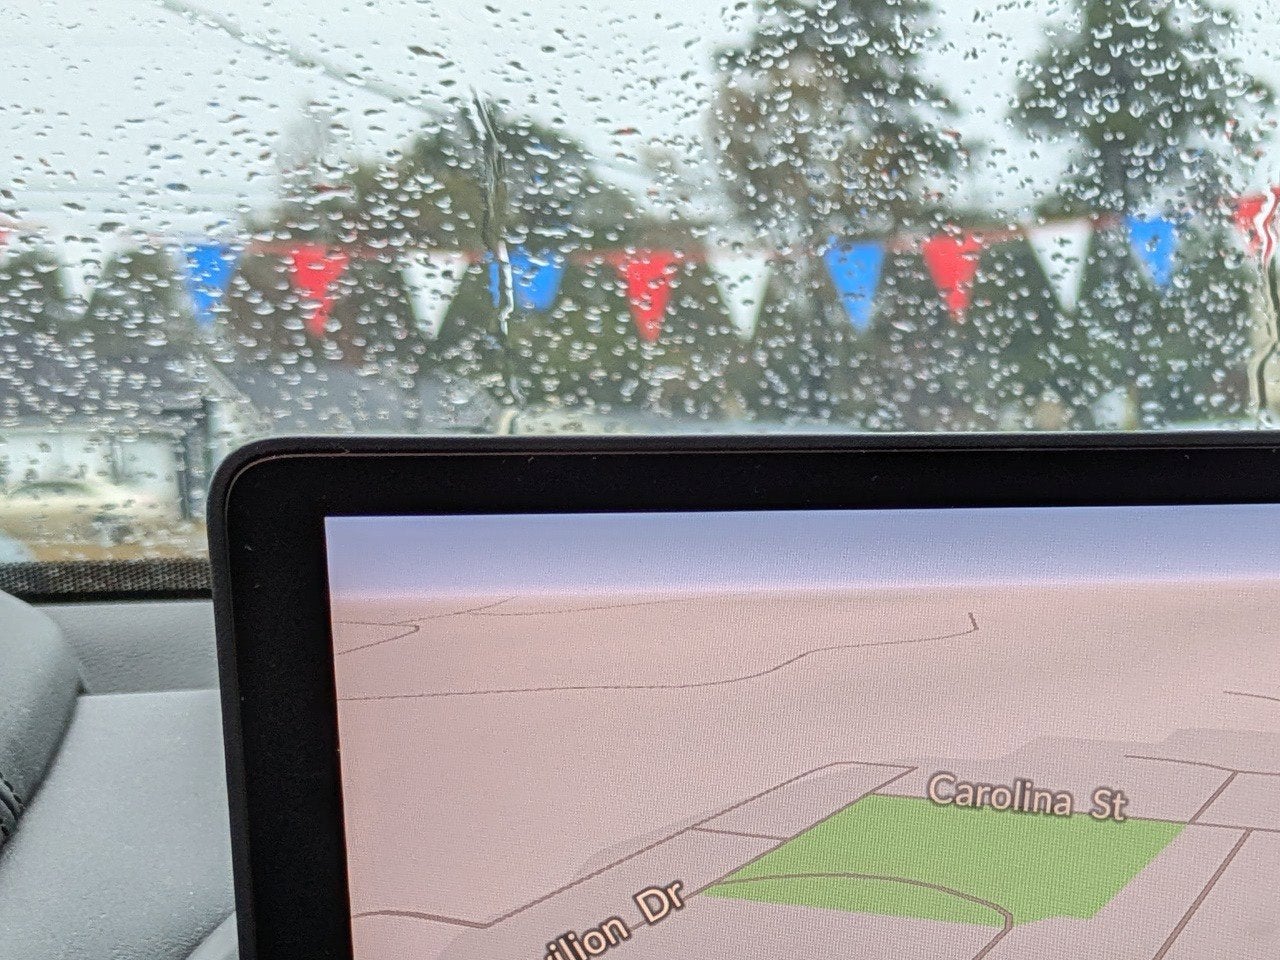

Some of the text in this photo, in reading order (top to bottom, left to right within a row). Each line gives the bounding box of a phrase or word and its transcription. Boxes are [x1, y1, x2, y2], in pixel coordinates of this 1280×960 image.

[929, 773, 1127, 821] Carolina St
[634, 883, 683, 922] Dr
